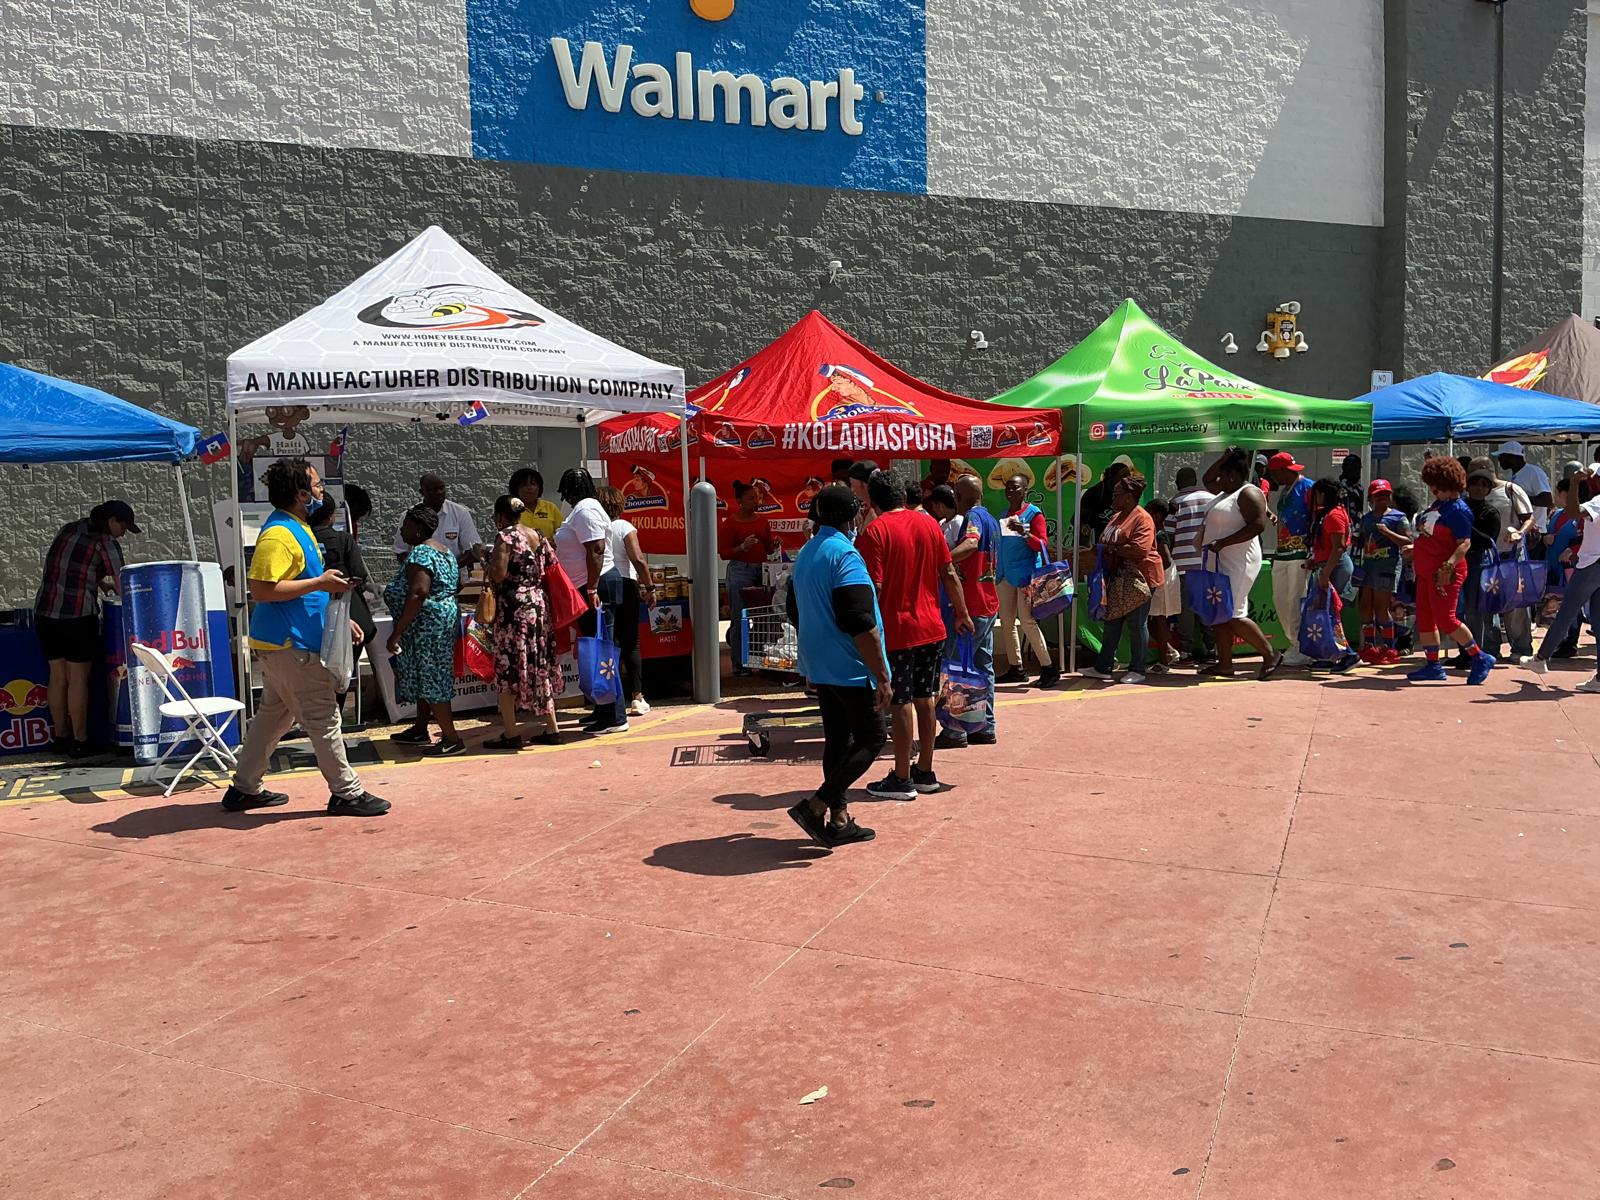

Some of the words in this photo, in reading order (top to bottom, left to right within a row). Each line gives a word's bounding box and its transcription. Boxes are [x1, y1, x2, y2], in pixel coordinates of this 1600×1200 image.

[551, 36, 864, 136] Walmart
[362, 340, 447, 348] MANUFACTURER
[449, 341, 517, 351] DISTRIBUTION
[520, 346, 566, 355] COMPANY
[381, 333, 537, 347] WWW.HONEYBEEDELIVERY.COM
[245, 373, 259, 392] A
[267, 368, 440, 391] MANUFACTURER
[447, 368, 581, 394] DISTRIBUTION
[588, 379, 674, 400] COMPANY
[1129, 421, 1209, 437] @LaPaixBakery
[1228, 417, 1364, 434] www.lapaixbakery.com
[782, 422, 957, 451] #KOLADIASPORA
[171, 628, 208, 651] Bull
